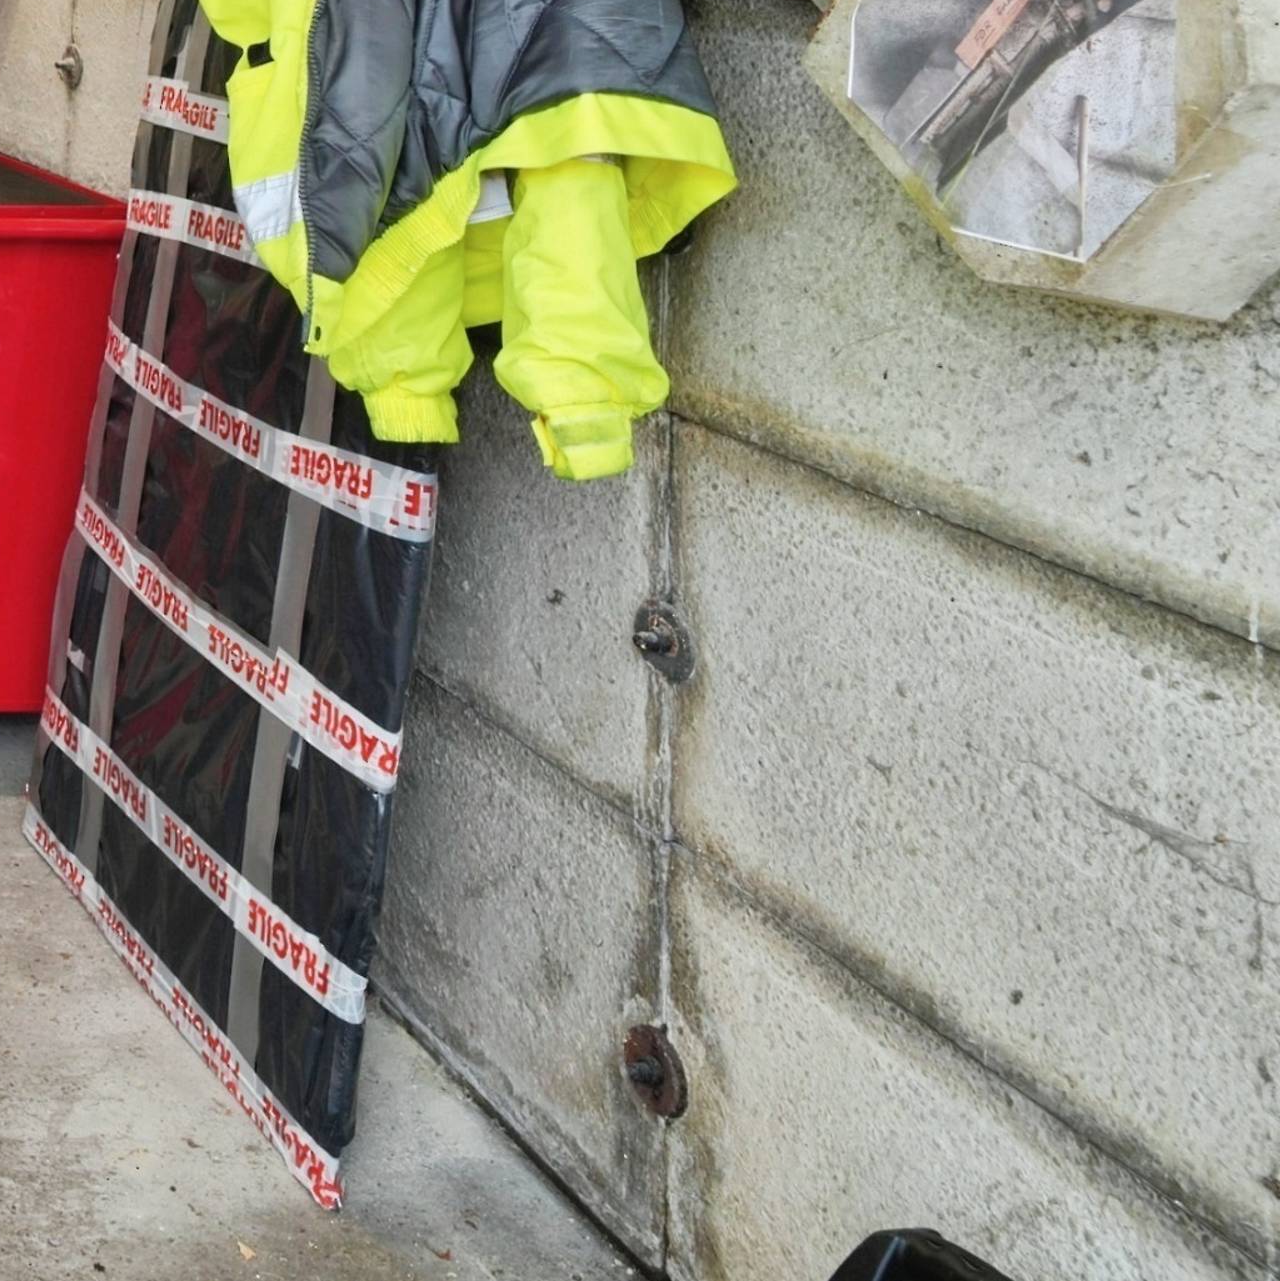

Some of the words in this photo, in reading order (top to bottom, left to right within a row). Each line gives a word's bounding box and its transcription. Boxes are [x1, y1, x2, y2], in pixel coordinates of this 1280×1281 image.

[187, 209, 246, 251] FRAGILE
[135, 356, 183, 413] FRAGILE
[199, 399, 261, 459] FRAGILE
[290, 444, 373, 500] FRAGILE
[136, 563, 189, 632] FRAGILE
[309, 688, 399, 776] RAGILE
[92, 746, 148, 823] FRAGILE
[163, 814, 229, 901] FRAGILE
[248, 898, 331, 995] FRAGILE
